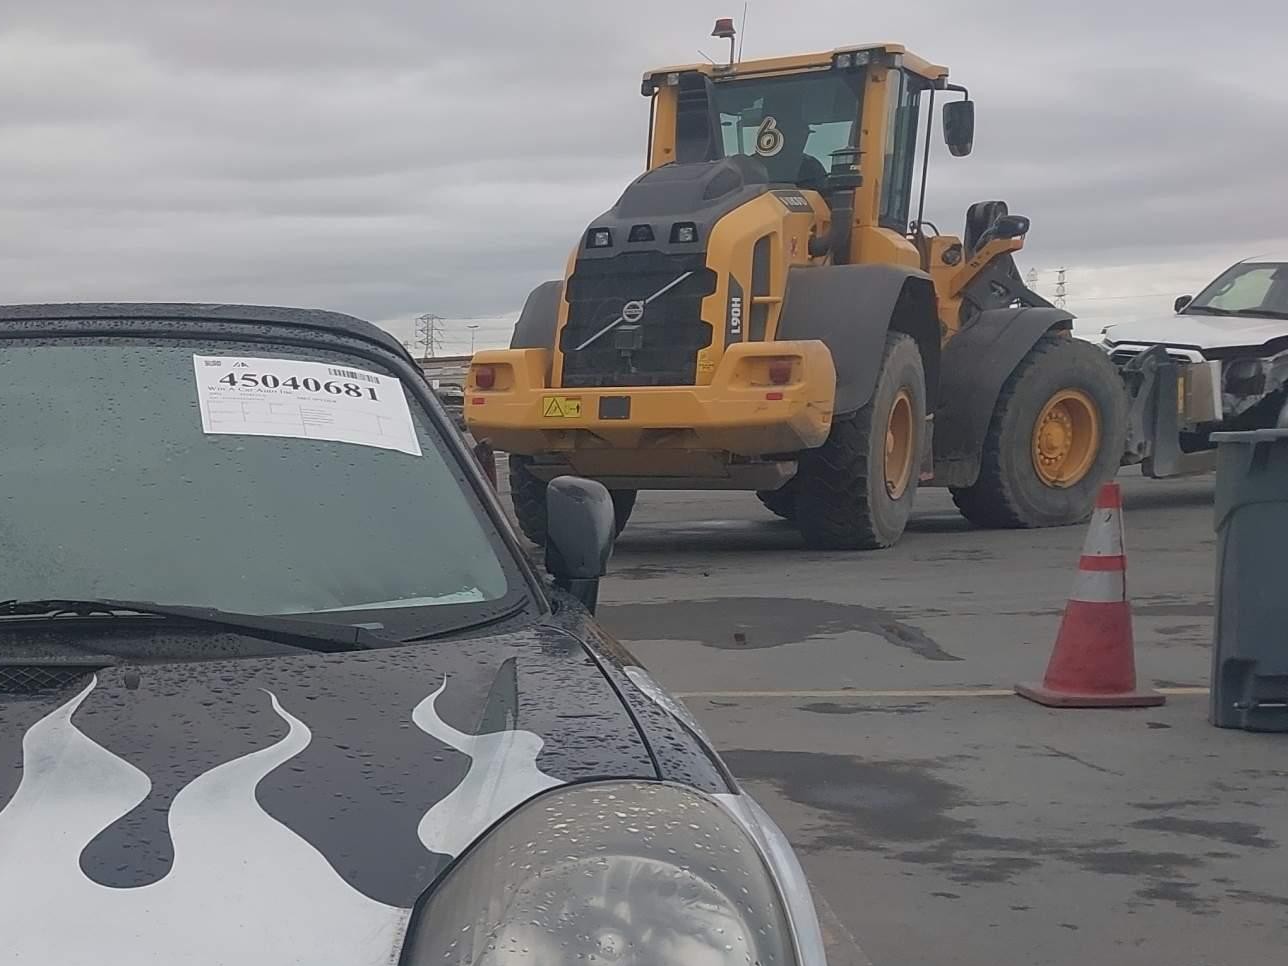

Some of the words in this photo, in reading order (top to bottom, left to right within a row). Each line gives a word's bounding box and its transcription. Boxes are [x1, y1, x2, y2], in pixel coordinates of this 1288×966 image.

[755, 116, 784, 155] 6
[731, 297, 742, 334] L90H
[219, 373, 380, 402] 45040681
